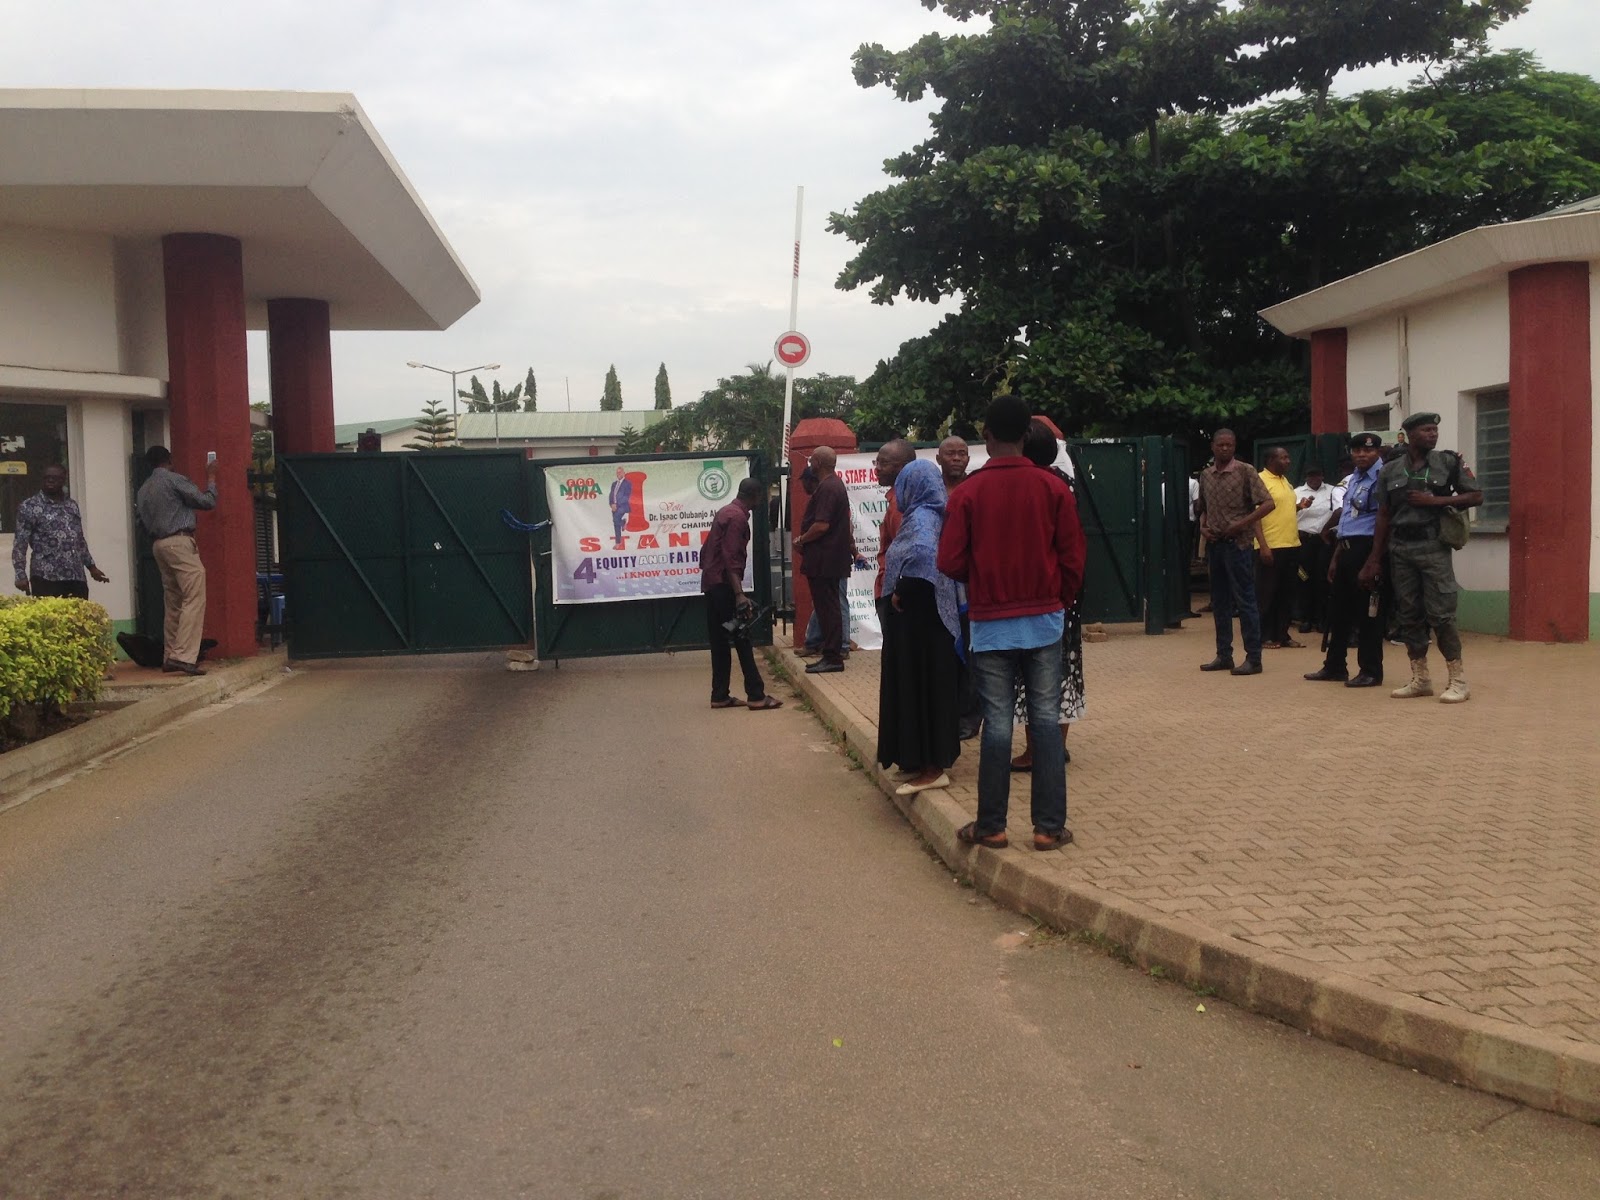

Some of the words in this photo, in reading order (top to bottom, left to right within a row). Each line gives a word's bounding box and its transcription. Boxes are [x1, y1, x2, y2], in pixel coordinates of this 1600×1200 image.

[845, 469, 867, 484] STAFF
[566, 478, 594, 487] FCT
[560, 483, 603, 496] NMA
[566, 491, 597, 500] 2016
[659, 502, 684, 511] Vote
[649, 513, 658, 521] Dr.
[680, 511, 708, 520] Olubanjo
[655, 520, 679, 534] for
[573, 557, 597, 584] 4
[596, 556, 637, 570] EQUITY
[638, 554, 668, 565] AND
[630, 570, 661, 579] KNOW
[855, 588, 873, 596] Date:
[857, 600, 867, 608] the
